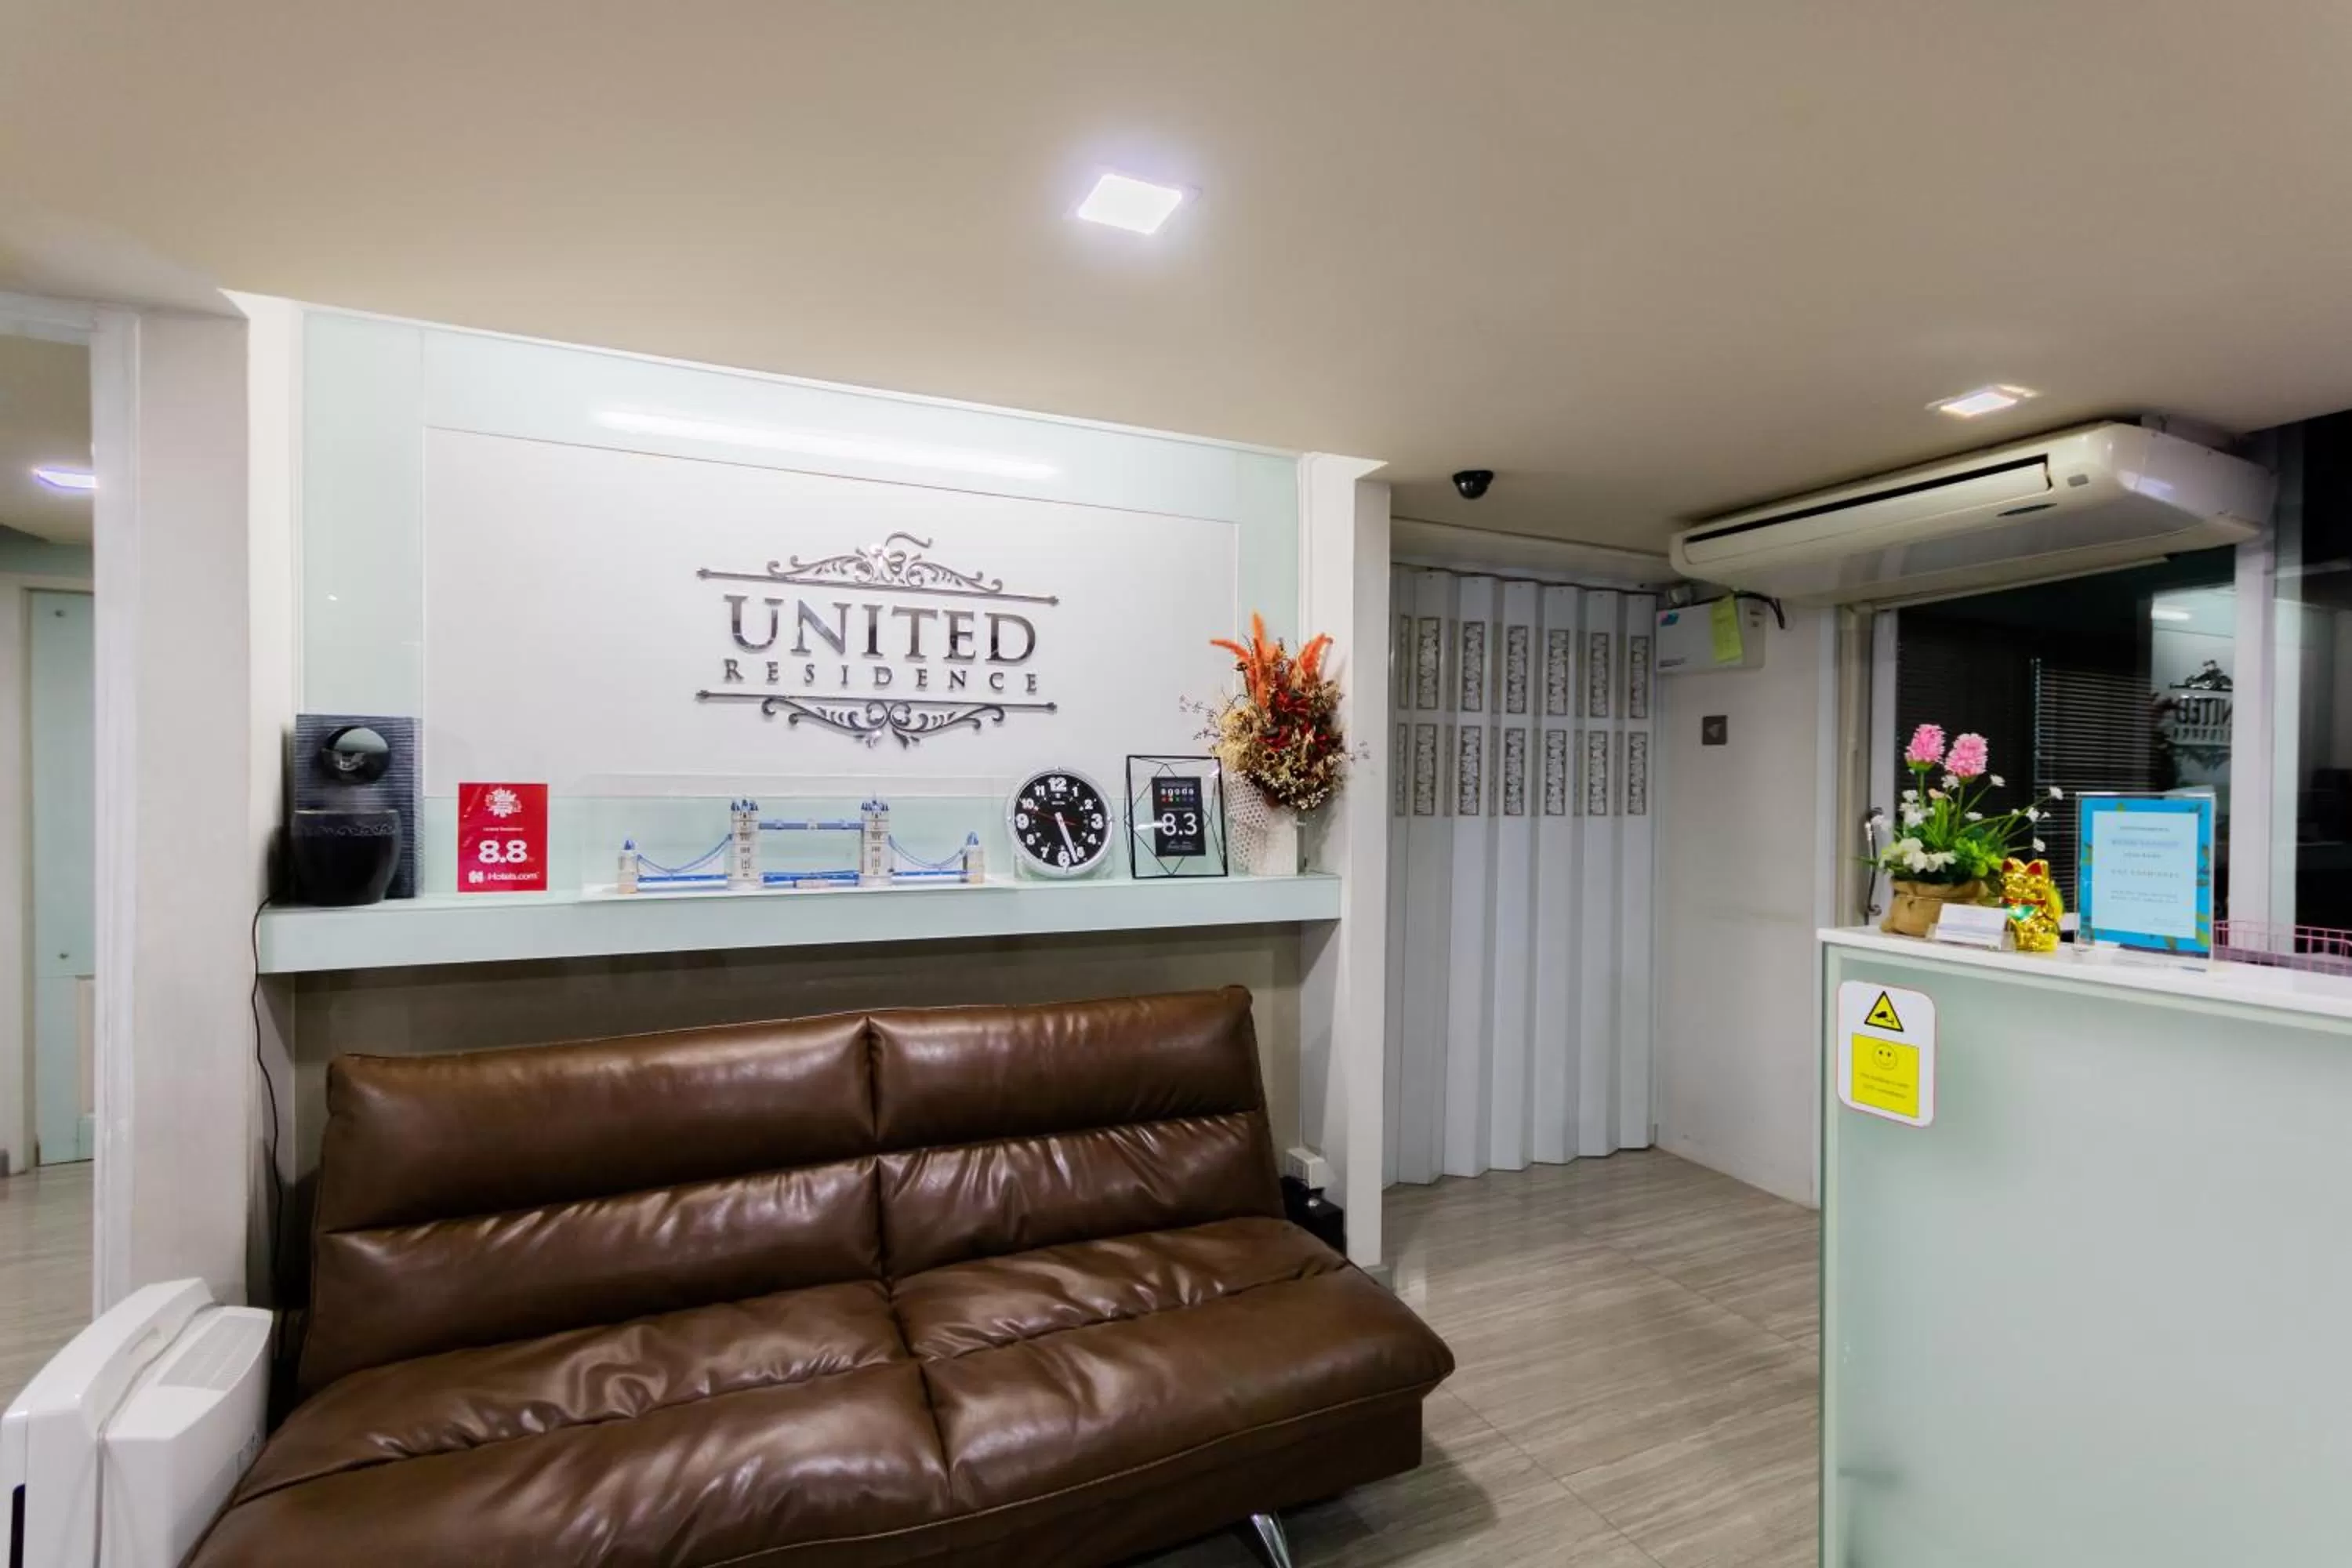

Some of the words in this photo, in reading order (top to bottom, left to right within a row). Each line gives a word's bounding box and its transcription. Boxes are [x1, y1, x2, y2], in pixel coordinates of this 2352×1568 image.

[723, 593, 1037, 663] UNITED
[723, 658, 1038, 692] RESIDENCE
[1048, 777, 1067, 792] 12
[1035, 786, 1045, 797] 11
[1072, 786, 1078, 797] 1
[1161, 786, 1194, 797] agoda
[1021, 798, 1034, 810] 10
[1084, 799, 1094, 810] 2
[1016, 813, 1029, 829] 9
[1091, 813, 1103, 829] 3
[1162, 812, 1197, 837] 8.3
[1026, 833, 1036, 845] 8
[1087, 833, 1096, 844] 4
[478, 840, 528, 863] 8.8
[1040, 847, 1049, 858] 7
[1058, 851, 1070, 866] 6
